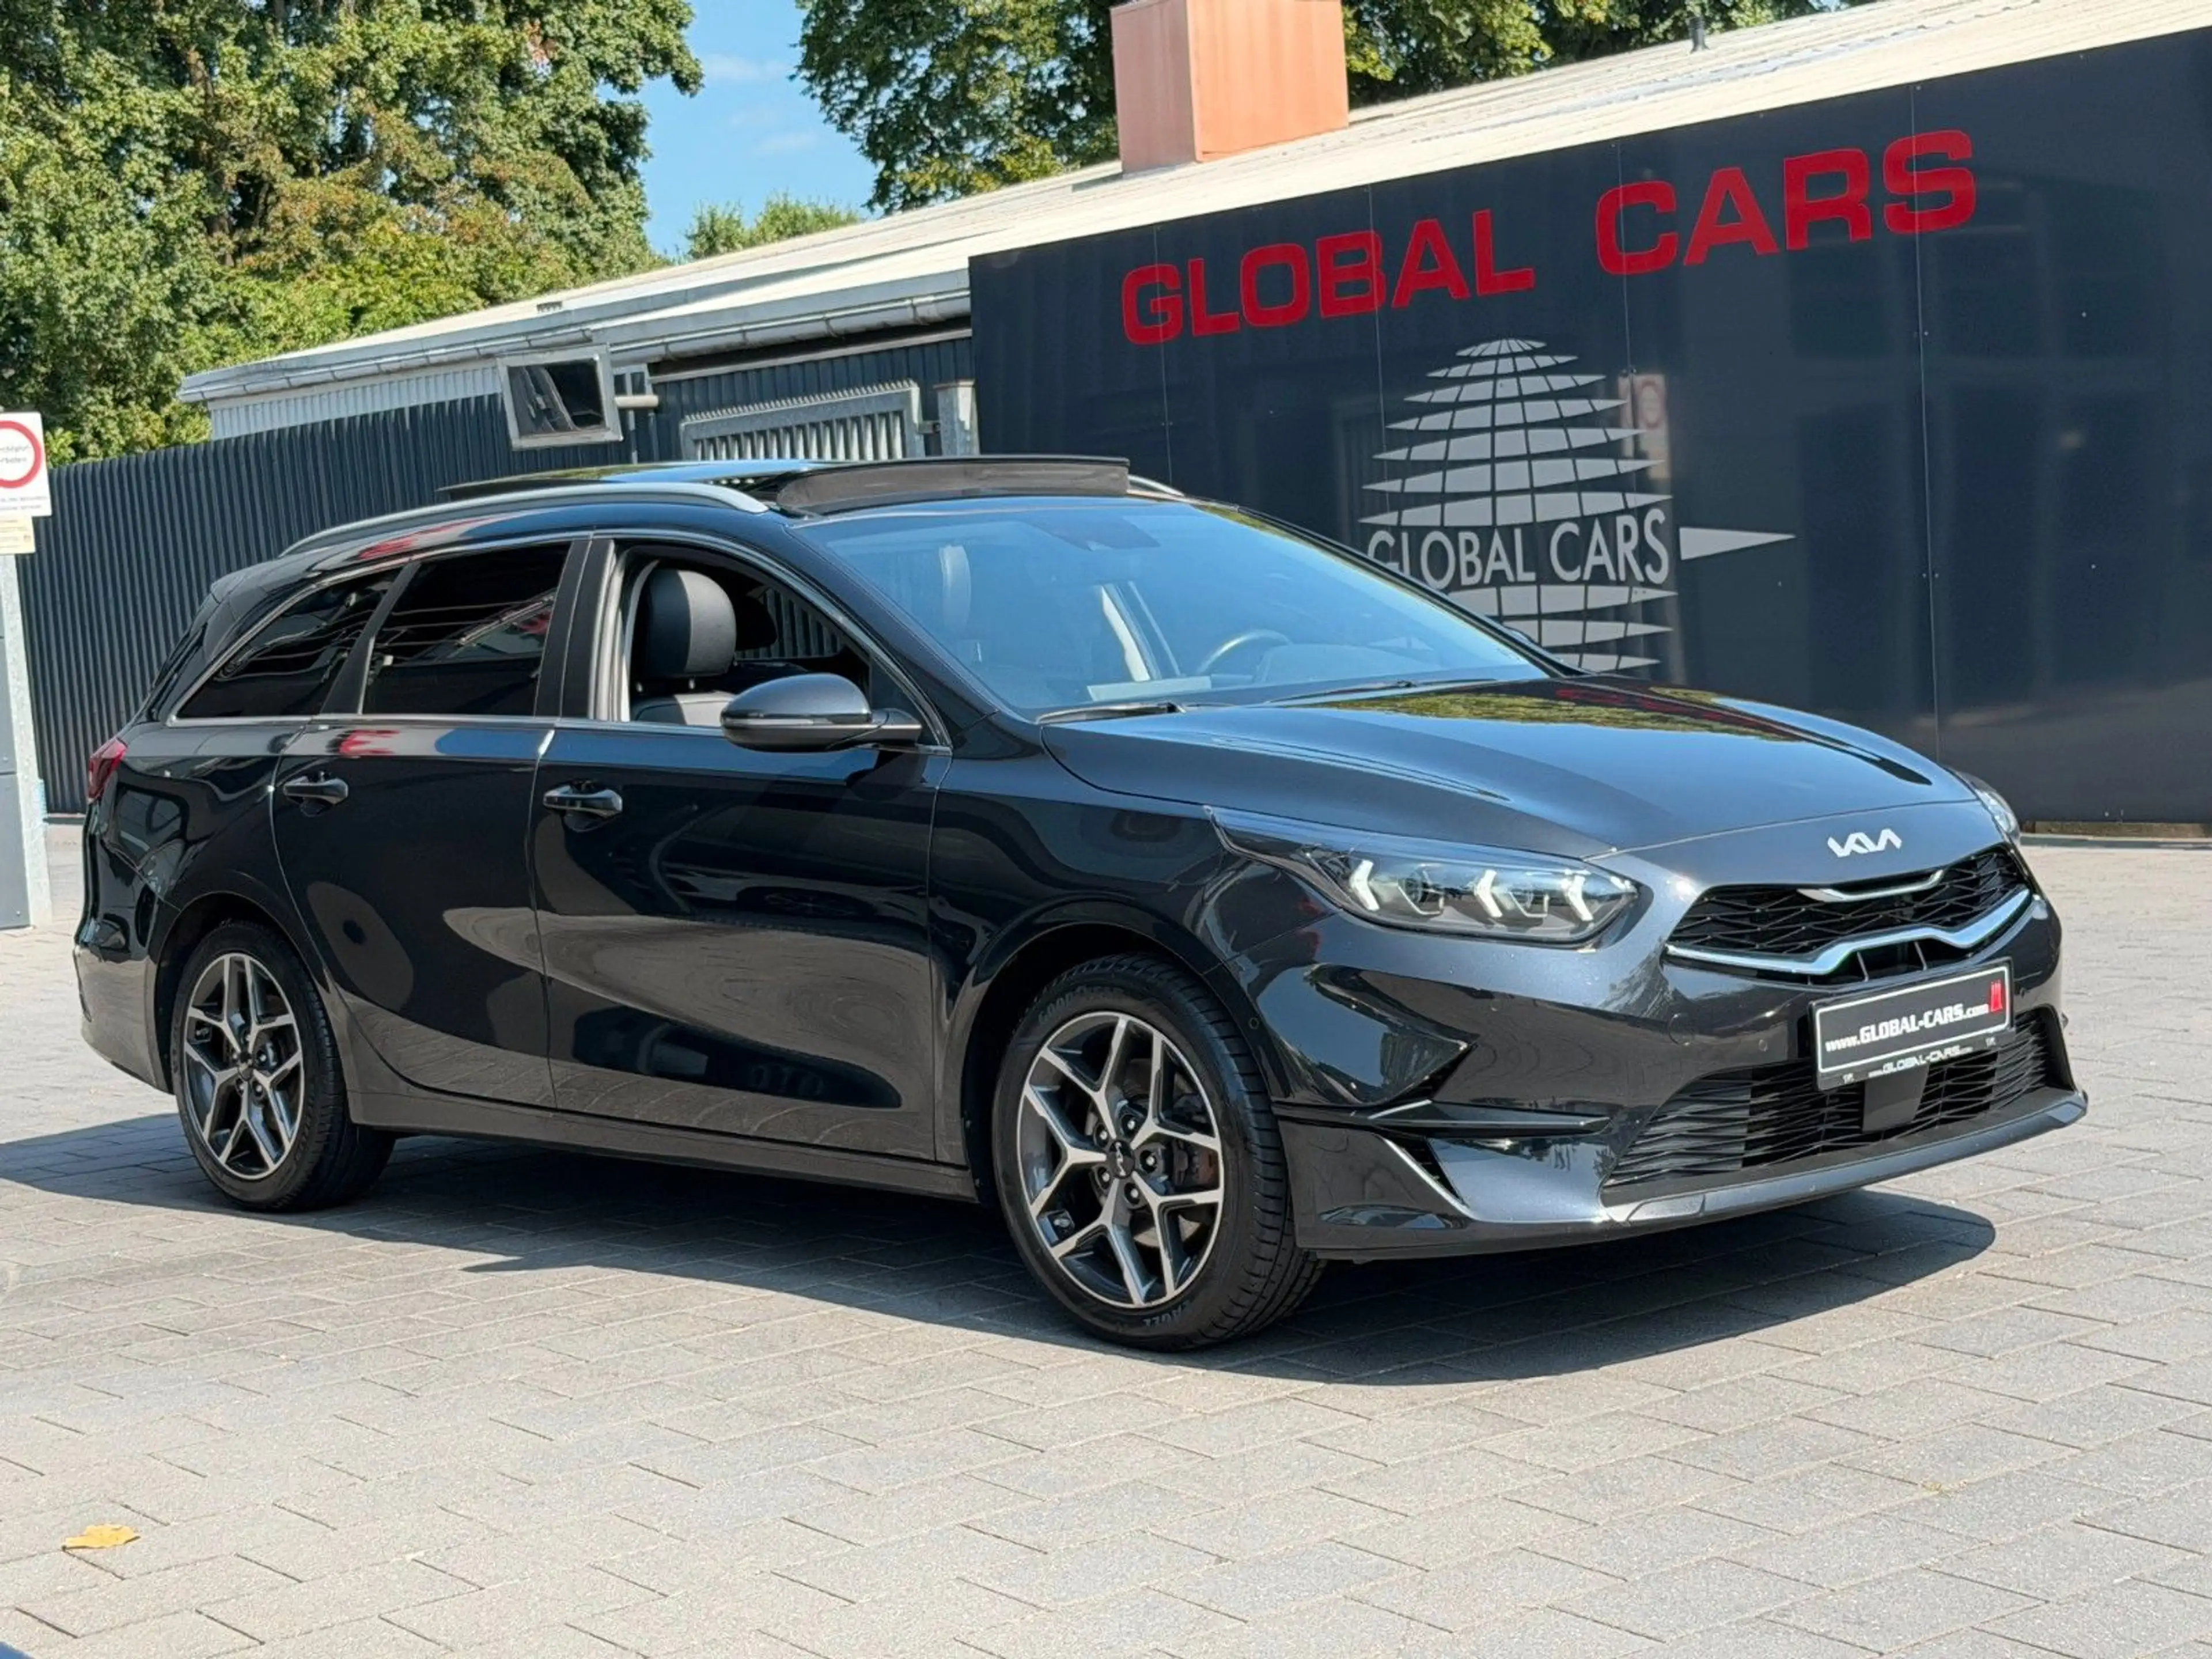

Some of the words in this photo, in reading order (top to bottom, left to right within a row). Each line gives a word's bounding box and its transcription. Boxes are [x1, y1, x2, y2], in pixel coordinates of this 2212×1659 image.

[1122, 210, 1535, 344] GLOBAL
[1595, 130, 1976, 275] CARS
[1367, 528, 1536, 590] GLOBAL
[1550, 507, 1671, 585] CARS
[1827, 828, 1903, 858] KIA
[1824, 1003, 1990, 1052] www.GLOBAL-CARS.com
